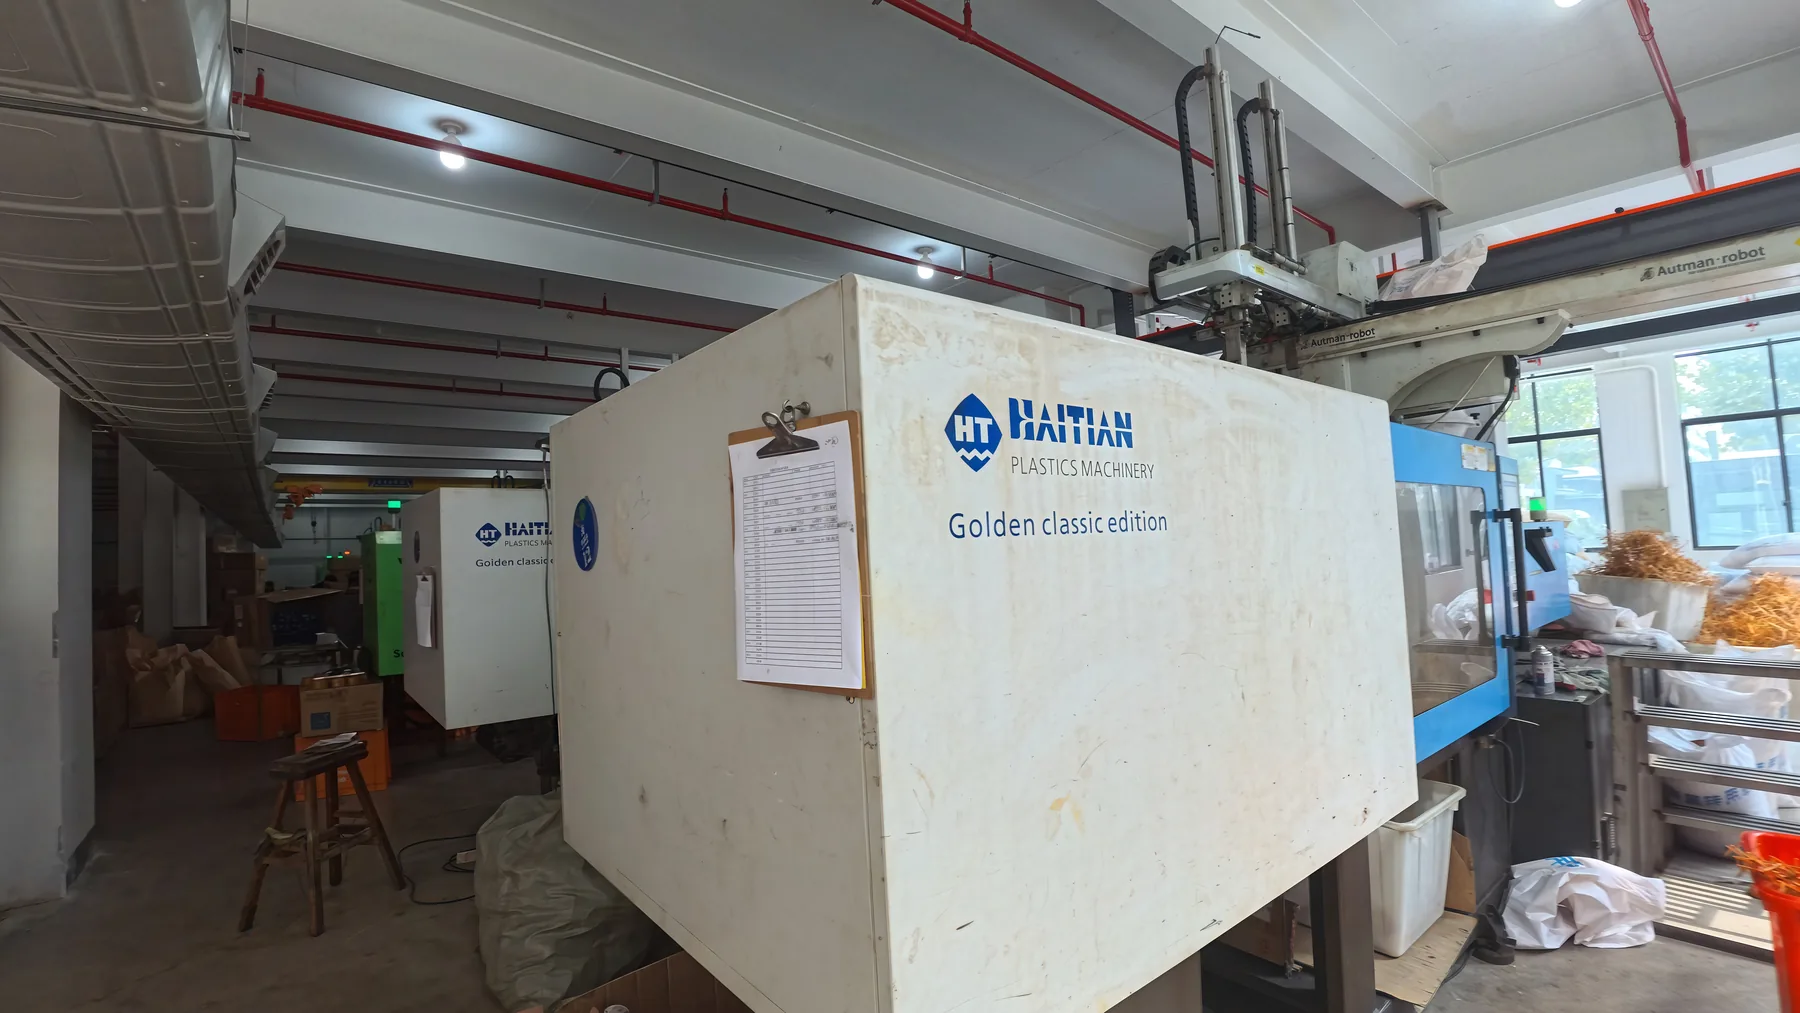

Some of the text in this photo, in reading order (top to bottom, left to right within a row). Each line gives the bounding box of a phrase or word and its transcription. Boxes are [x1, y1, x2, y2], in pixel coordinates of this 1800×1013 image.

[954, 414, 993, 443] HT
[1008, 397, 1133, 448] HAITIAN
[1011, 456, 1155, 480] PLASTICS MACHINERY
[480, 529, 498, 539] HT
[504, 522, 553, 536] HAITI
[949, 510, 1168, 539] Golden classic edition
[475, 558, 514, 567] Golden
[516, 556, 548, 566] classic
